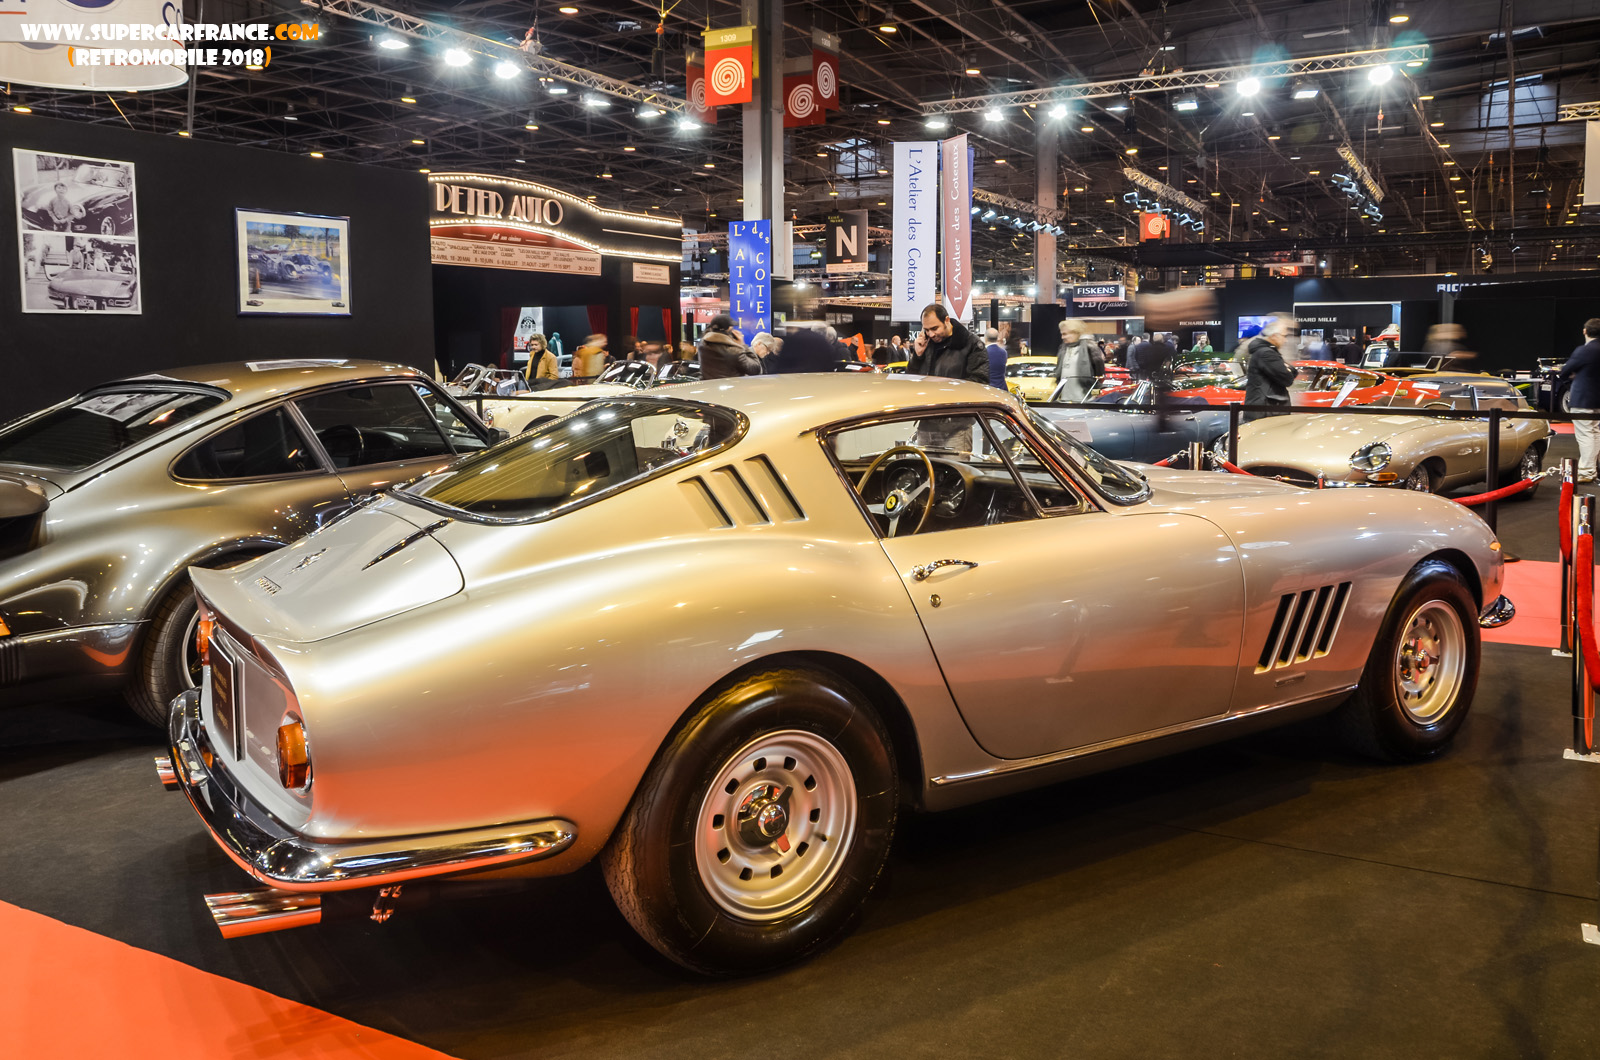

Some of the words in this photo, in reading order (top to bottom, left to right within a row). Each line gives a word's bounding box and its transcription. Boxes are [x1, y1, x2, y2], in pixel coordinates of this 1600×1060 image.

[720, 33, 737, 43] 1309
[908, 148, 923, 211] L'Atelier
[950, 143, 960, 201] Coteaux
[435, 182, 504, 219] PETER
[508, 194, 564, 226] AUTO
[951, 207, 960, 231] des
[751, 221, 770, 244] des
[836, 225, 858, 257] N
[907, 217, 922, 241] des
[906, 247, 922, 303] Coteaux
[951, 237, 963, 302] L'Atelier
[755, 252, 766, 330] COTEA
[1076, 286, 1116, 295] FISKENS
